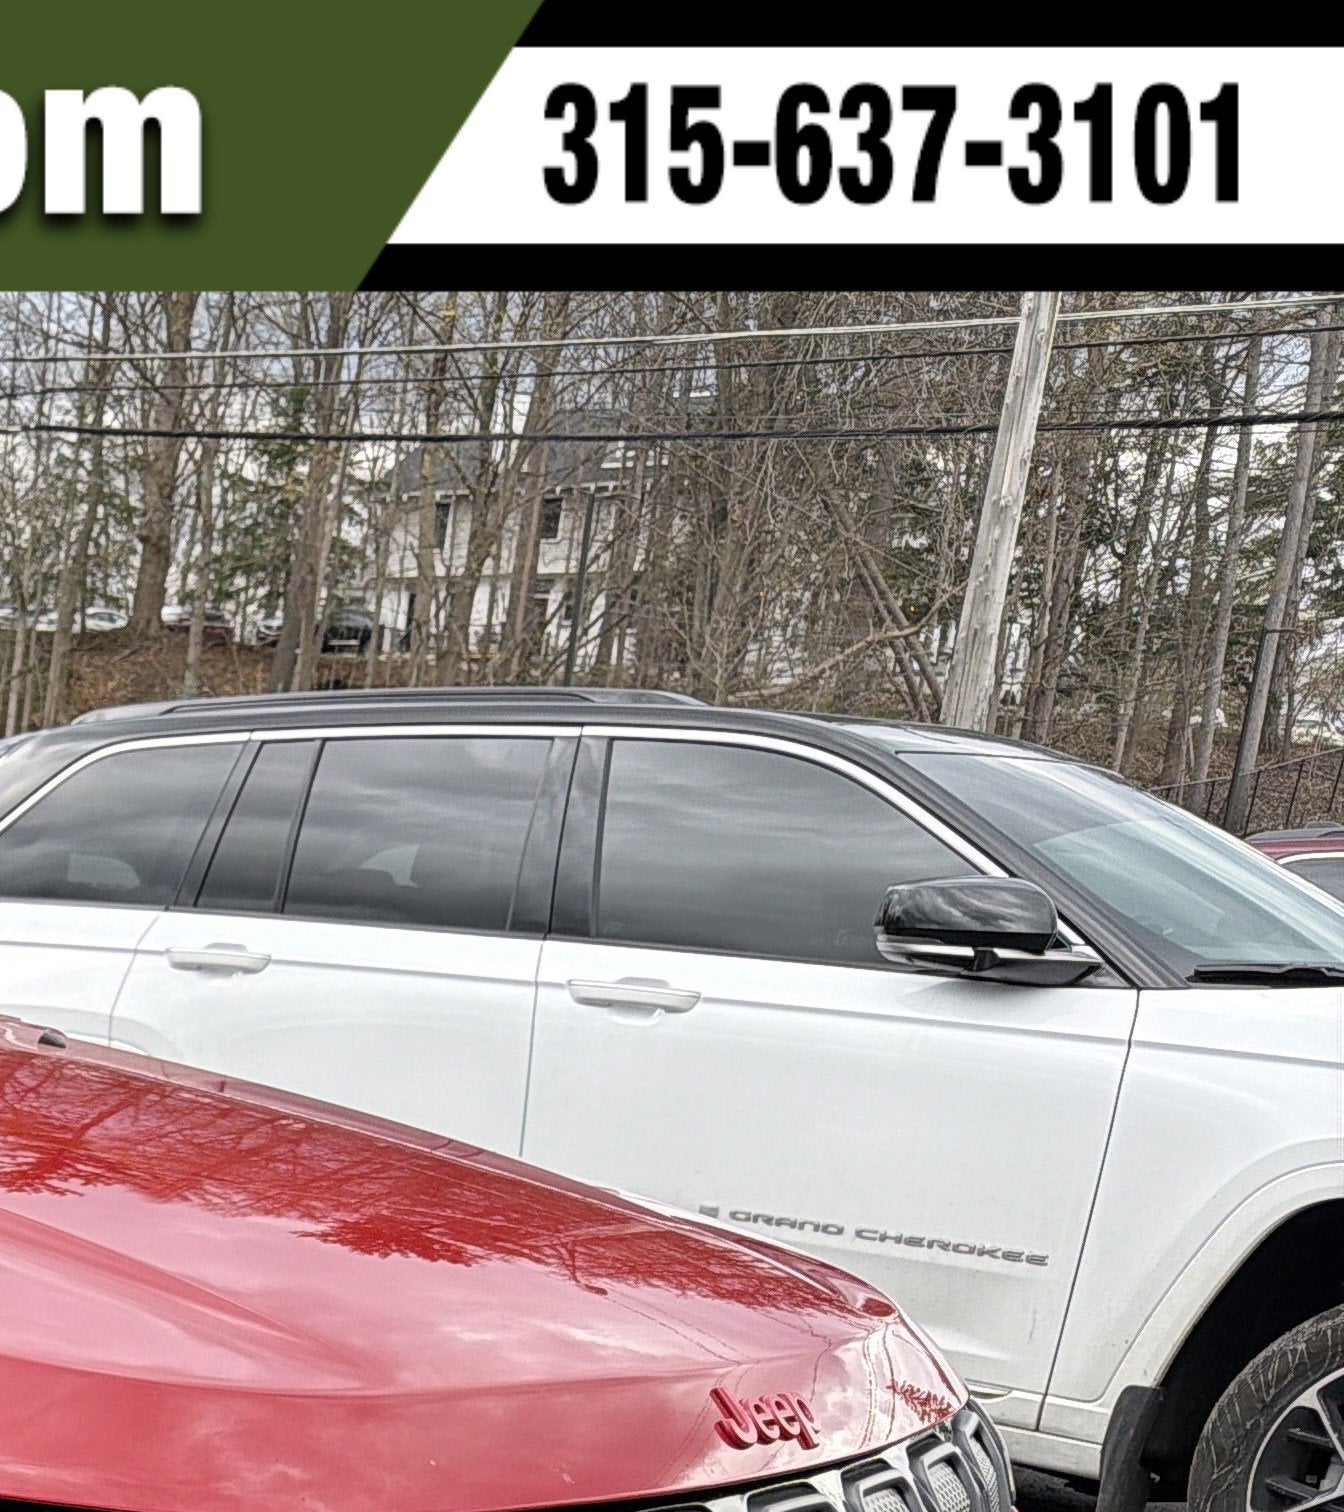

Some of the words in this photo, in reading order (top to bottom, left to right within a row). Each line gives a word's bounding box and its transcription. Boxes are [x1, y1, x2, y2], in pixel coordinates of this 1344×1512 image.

[729, 1208, 844, 1236] GRAND
[854, 1228, 1050, 1266] CHEROKEE
[709, 1387, 821, 1450] Jeep
